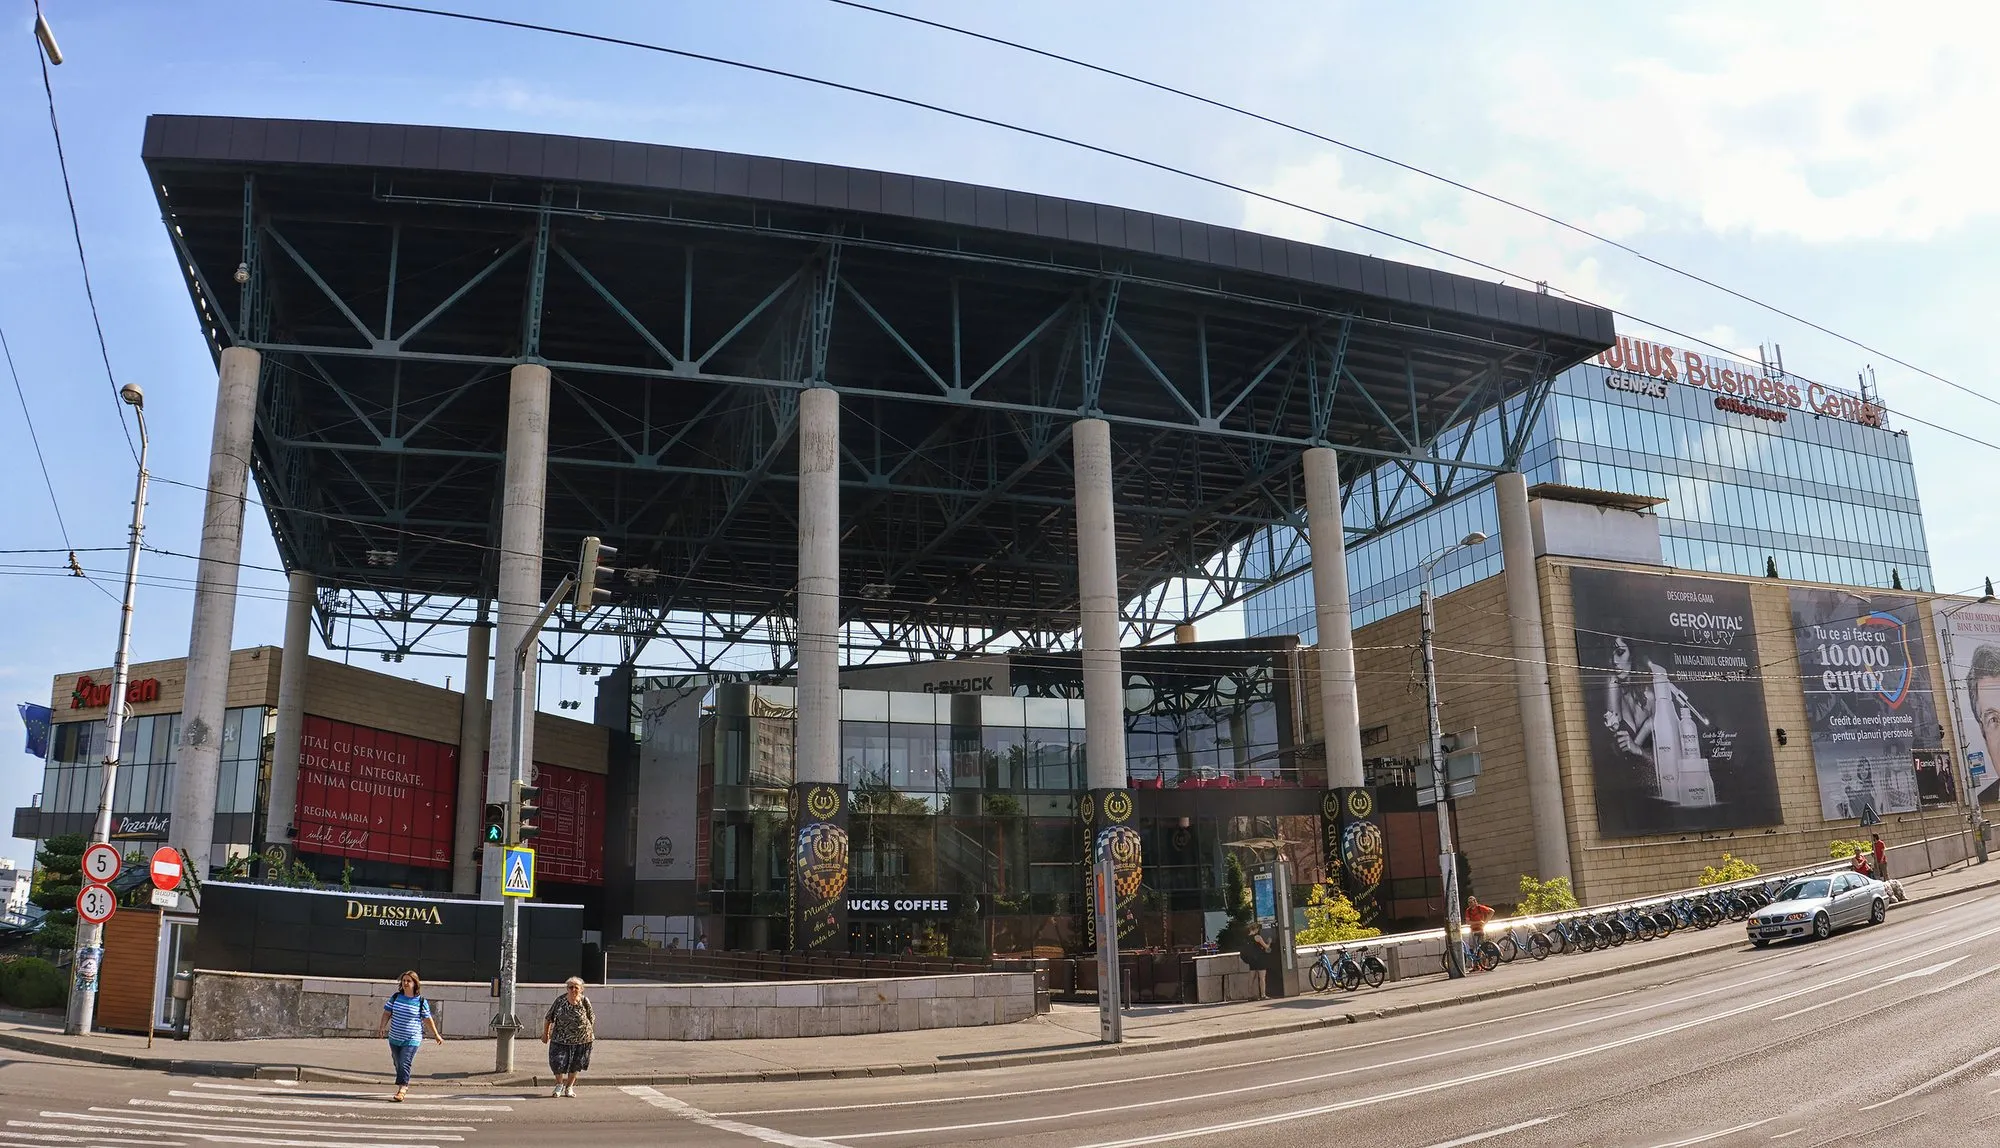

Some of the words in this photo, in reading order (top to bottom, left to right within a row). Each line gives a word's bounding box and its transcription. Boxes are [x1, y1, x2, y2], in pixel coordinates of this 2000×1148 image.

[1606, 374, 1669, 399] GENPACT
[1684, 352, 1801, 407] Business
[1807, 383, 1884, 427] Center
[1697, 593, 1714, 603] GAMA
[1814, 625, 1826, 640] Tu
[1829, 629, 1840, 640] ce
[1842, 627, 1852, 641] ai
[1853, 628, 1873, 642] face
[1874, 632, 1885, 642] cu
[1682, 655, 1718, 667] MAGAZINUL
[1718, 656, 1748, 667] GEROVITAL
[1817, 643, 1889, 667] 10.000
[1829, 715, 1851, 726] Credit
[1852, 715, 1862, 725] de
[1862, 715, 1882, 725] nevoi
[1882, 714, 1913, 726] personale
[1832, 731, 1857, 743] pentru
[1857, 729, 1881, 742] planuri
[1882, 728, 1913, 740] personale
[301, 735, 329, 750] ITAL
[333, 741, 350, 754] CU
[353, 745, 406, 765] SERVICII
[299, 753, 350, 773] EDICALE
[308, 772, 346, 788] INIMA
[350, 780, 405, 799] CLUJULUI
[146, 815, 169, 831] Hut
[303, 805, 337, 819] REGINA
[340, 811, 368, 824] MARIA
[97, 854, 107, 873] 5
[1084, 828, 1096, 947] WONDERLAND
[346, 899, 443, 925] DELISSIMA
[894, 899, 949, 911] COFFEE
[379, 918, 410, 927] BAKERY
